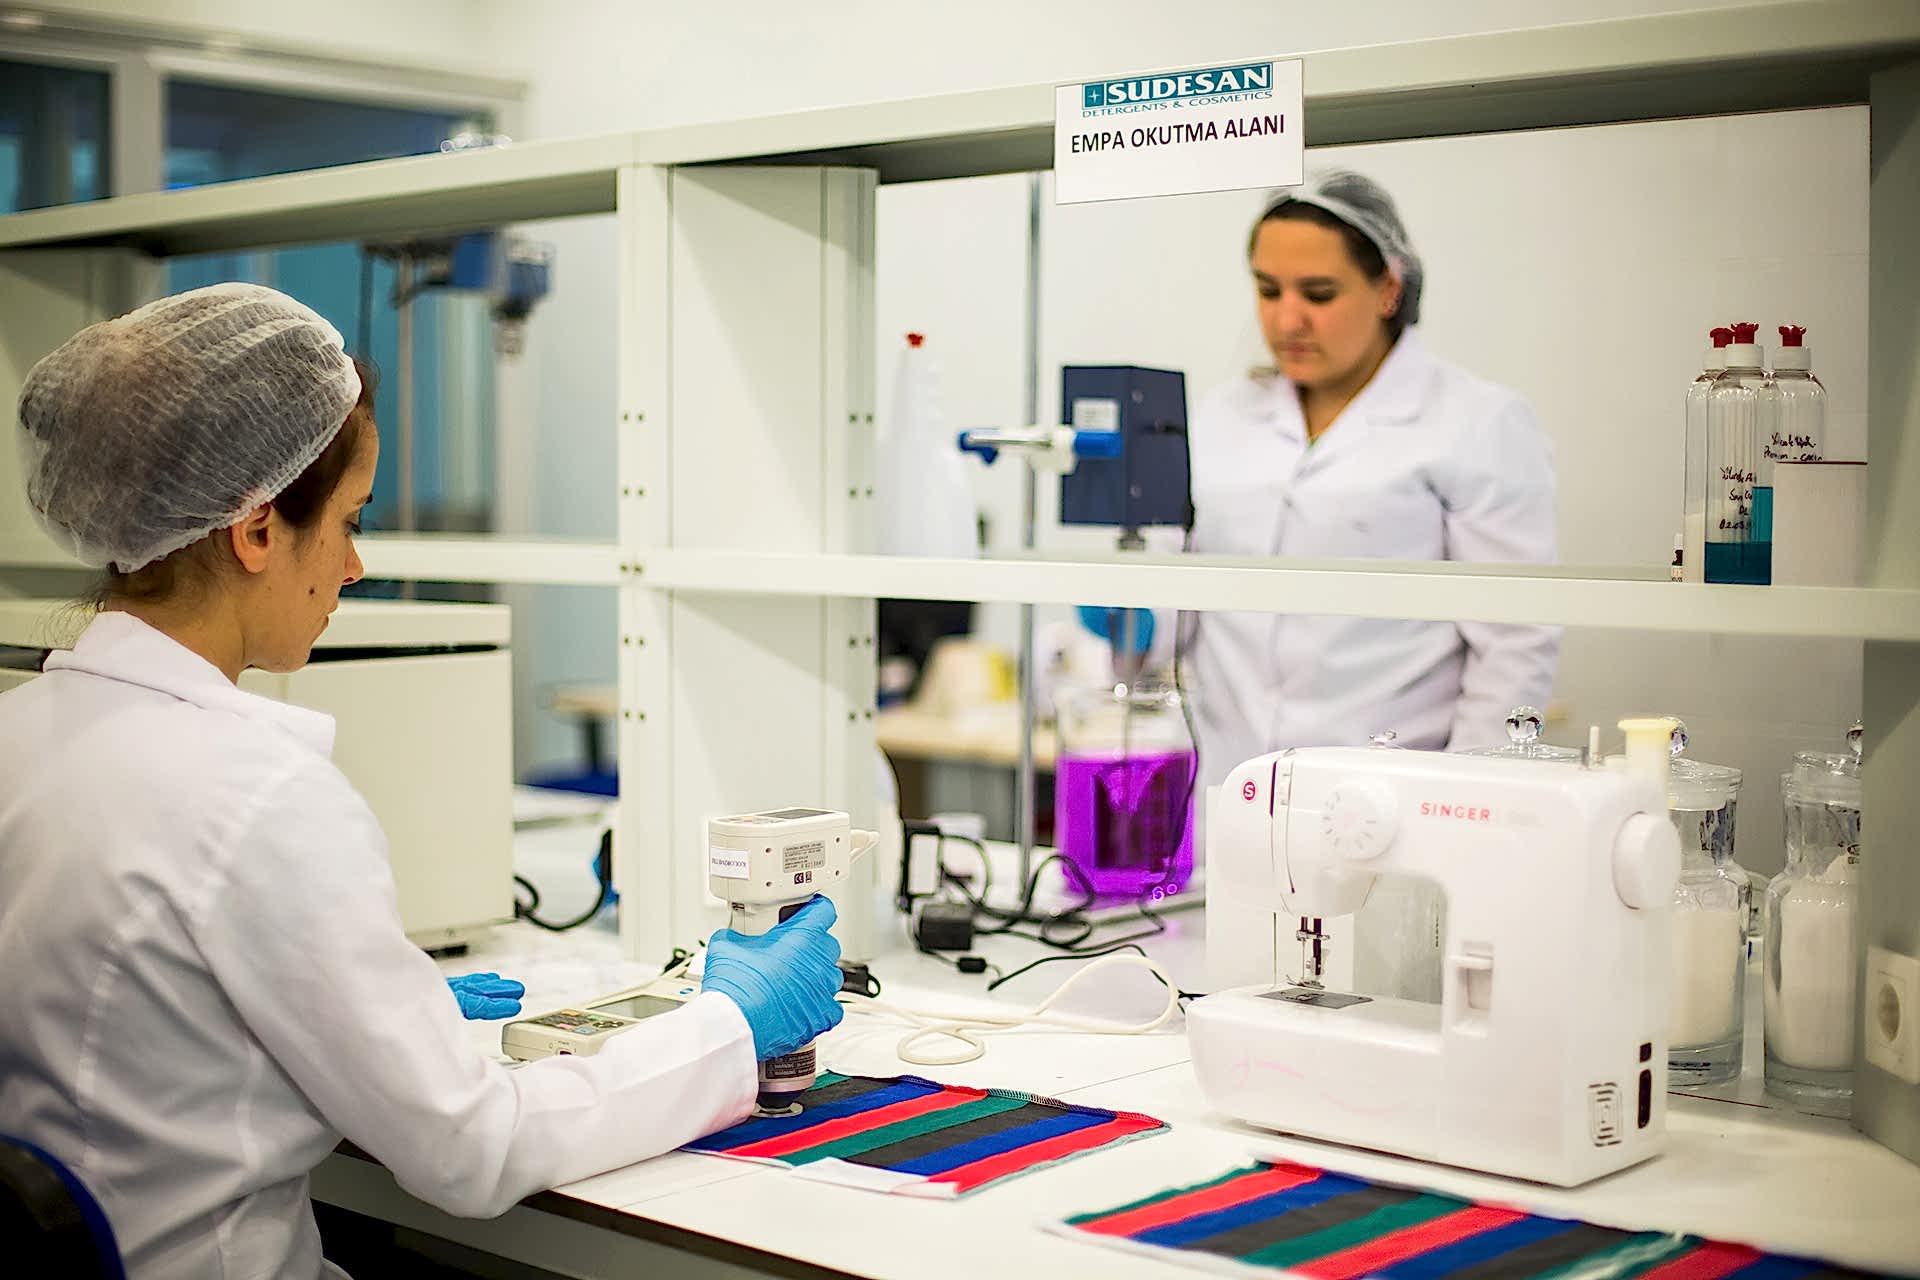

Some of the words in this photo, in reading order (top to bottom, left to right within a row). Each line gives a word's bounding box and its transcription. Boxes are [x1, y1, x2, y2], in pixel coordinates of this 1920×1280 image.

[1107, 66, 1268, 104] SUDESAN
[1082, 101, 1168, 118] DETERGENTS
[1173, 100, 1184, 108] &
[1189, 91, 1273, 107] COSMETICS
[1071, 131, 1125, 153] EMPA
[1131, 121, 1218, 147] OKUTMA
[1224, 114, 1285, 139] ALANI
[1420, 802, 1490, 821] SINGER
